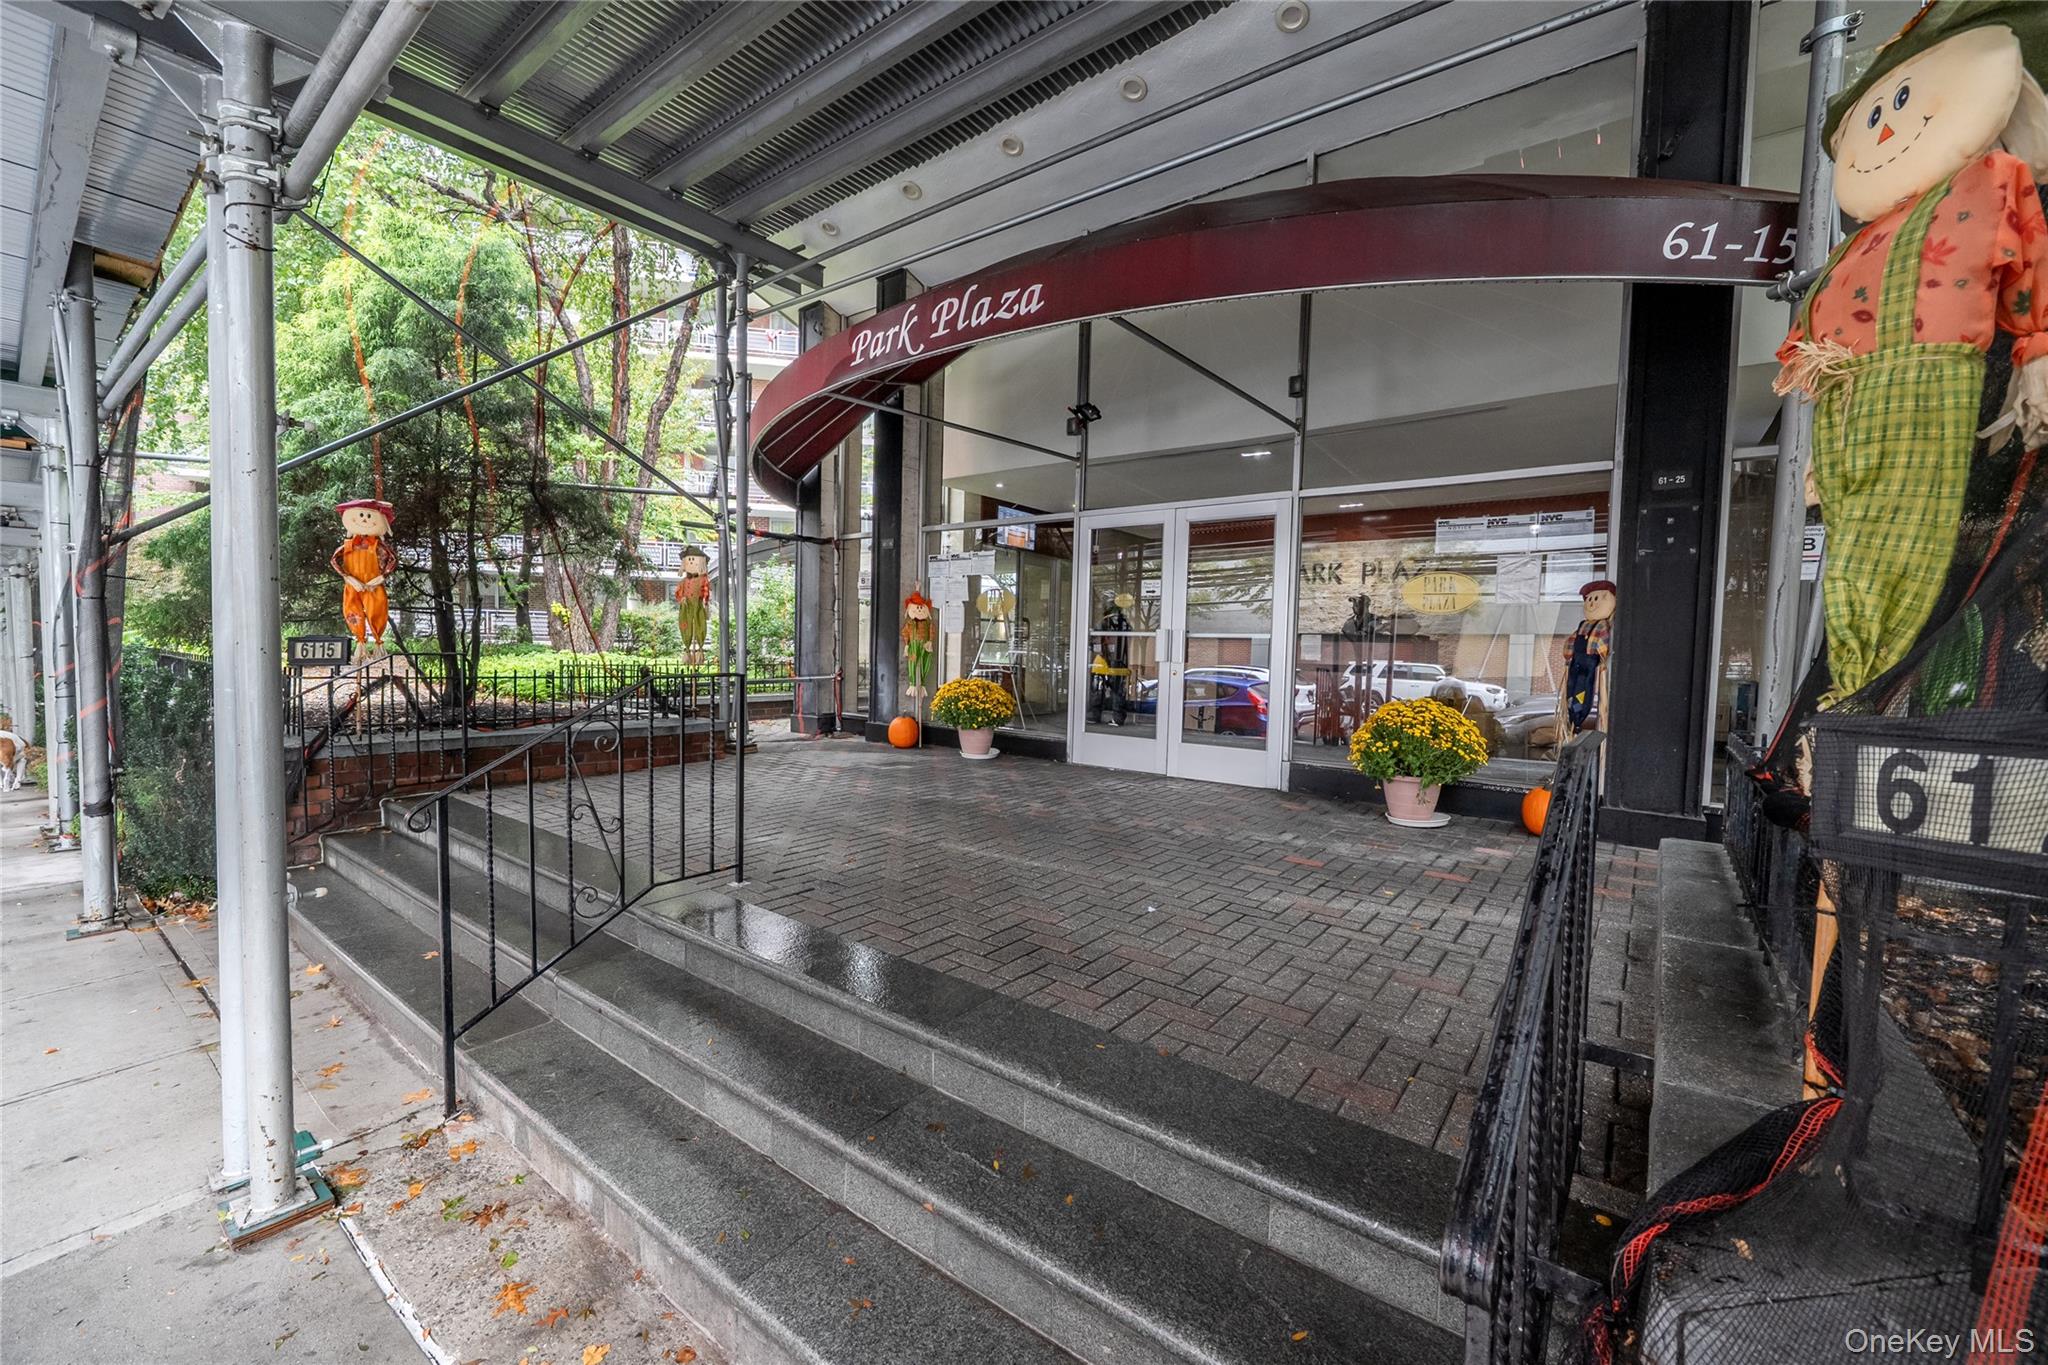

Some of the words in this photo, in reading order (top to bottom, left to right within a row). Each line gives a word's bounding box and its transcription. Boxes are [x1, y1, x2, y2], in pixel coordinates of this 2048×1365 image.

[1661, 221, 1798, 265] 61-15
[849, 303, 925, 367] Park
[929, 283, 1045, 339] Plaza
[1300, 561, 1343, 585] ARK
[1876, 750, 1996, 846] 61
